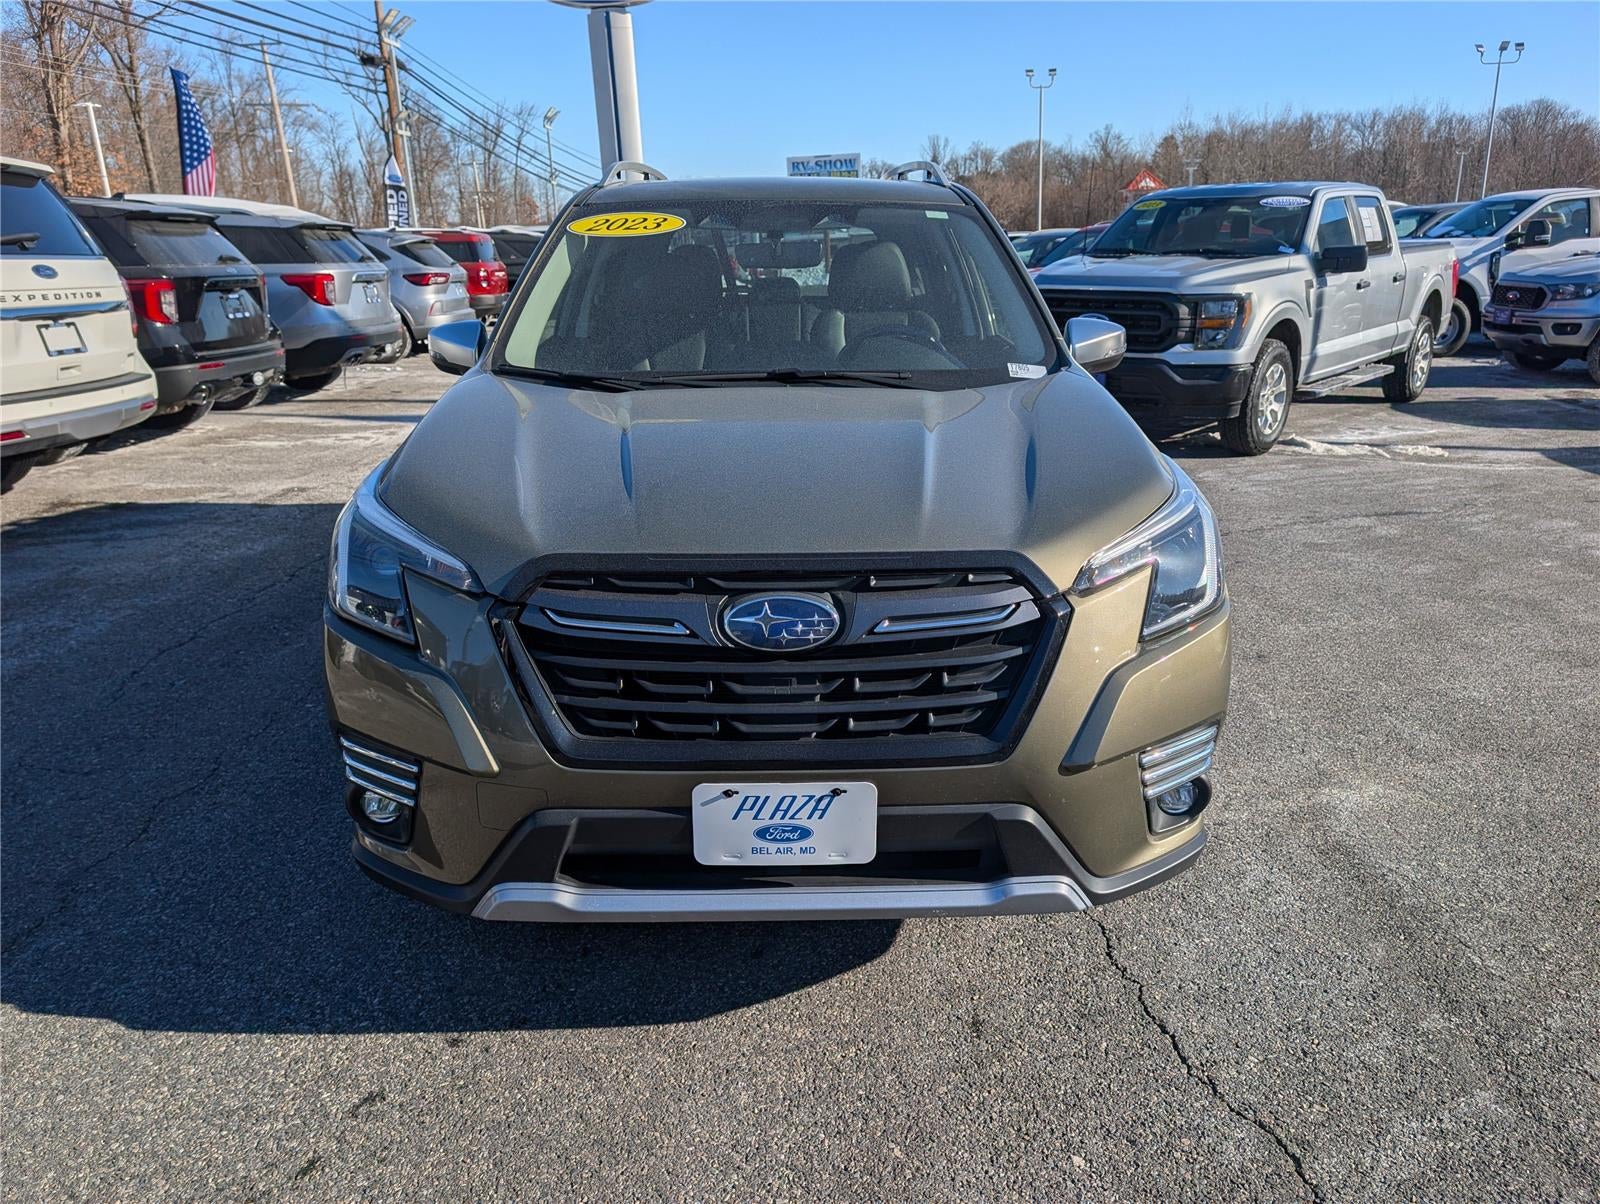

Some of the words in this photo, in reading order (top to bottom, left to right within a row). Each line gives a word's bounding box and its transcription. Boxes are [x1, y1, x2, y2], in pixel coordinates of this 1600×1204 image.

[791, 161, 809, 172] RV
[814, 158, 857, 171] SHOW
[585, 217, 668, 232] 2023
[731, 794, 837, 821] PLAZA
[765, 826, 801, 841] Ford
[751, 846, 772, 855] BEL
[775, 846, 797, 856] AIR,
[799, 846, 816, 855] MD
